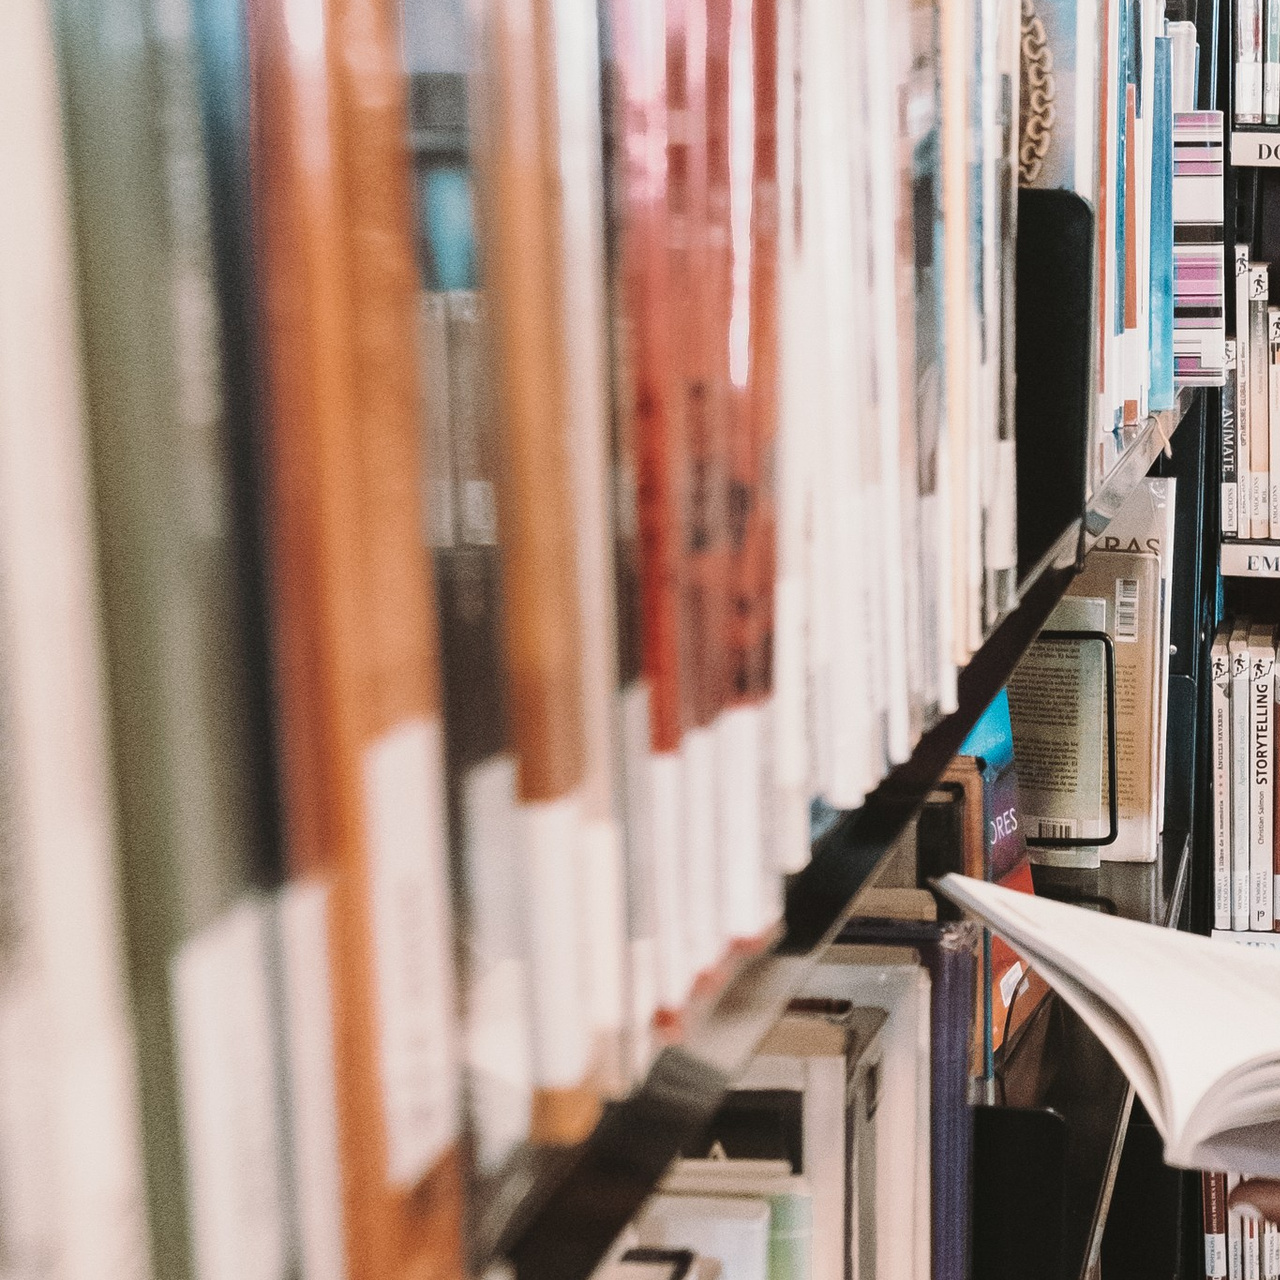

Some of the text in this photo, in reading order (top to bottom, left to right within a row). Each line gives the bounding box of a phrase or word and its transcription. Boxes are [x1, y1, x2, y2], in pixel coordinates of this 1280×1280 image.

[1256, 683, 1268, 786] STORYTELLING
[1257, 790, 1265, 846] Christian Salmon
